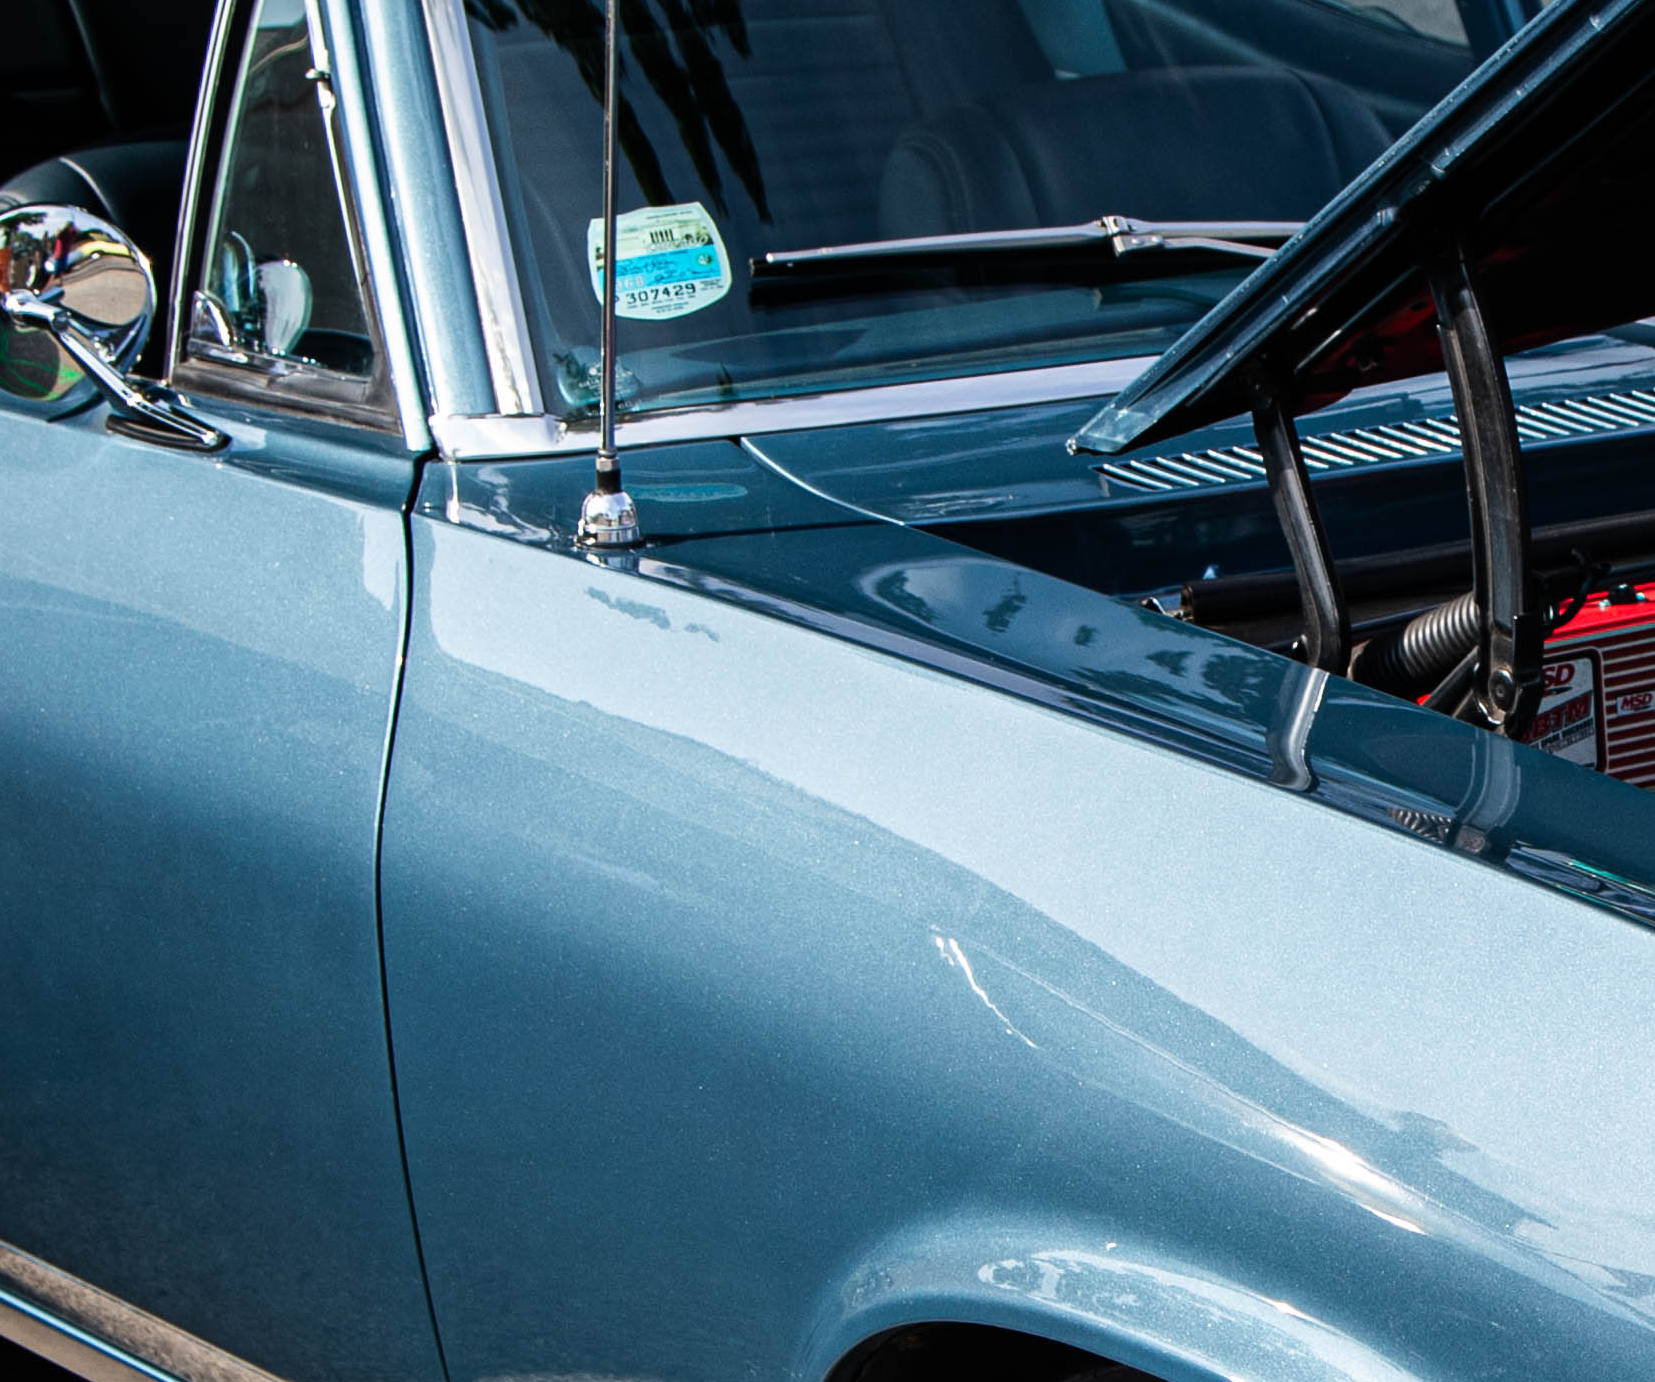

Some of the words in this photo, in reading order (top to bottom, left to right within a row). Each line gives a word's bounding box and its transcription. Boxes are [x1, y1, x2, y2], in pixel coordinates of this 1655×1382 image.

[626, 282, 697, 305] 307429
[1540, 663, 1576, 689] SD
[1621, 693, 1653, 711] MSD
